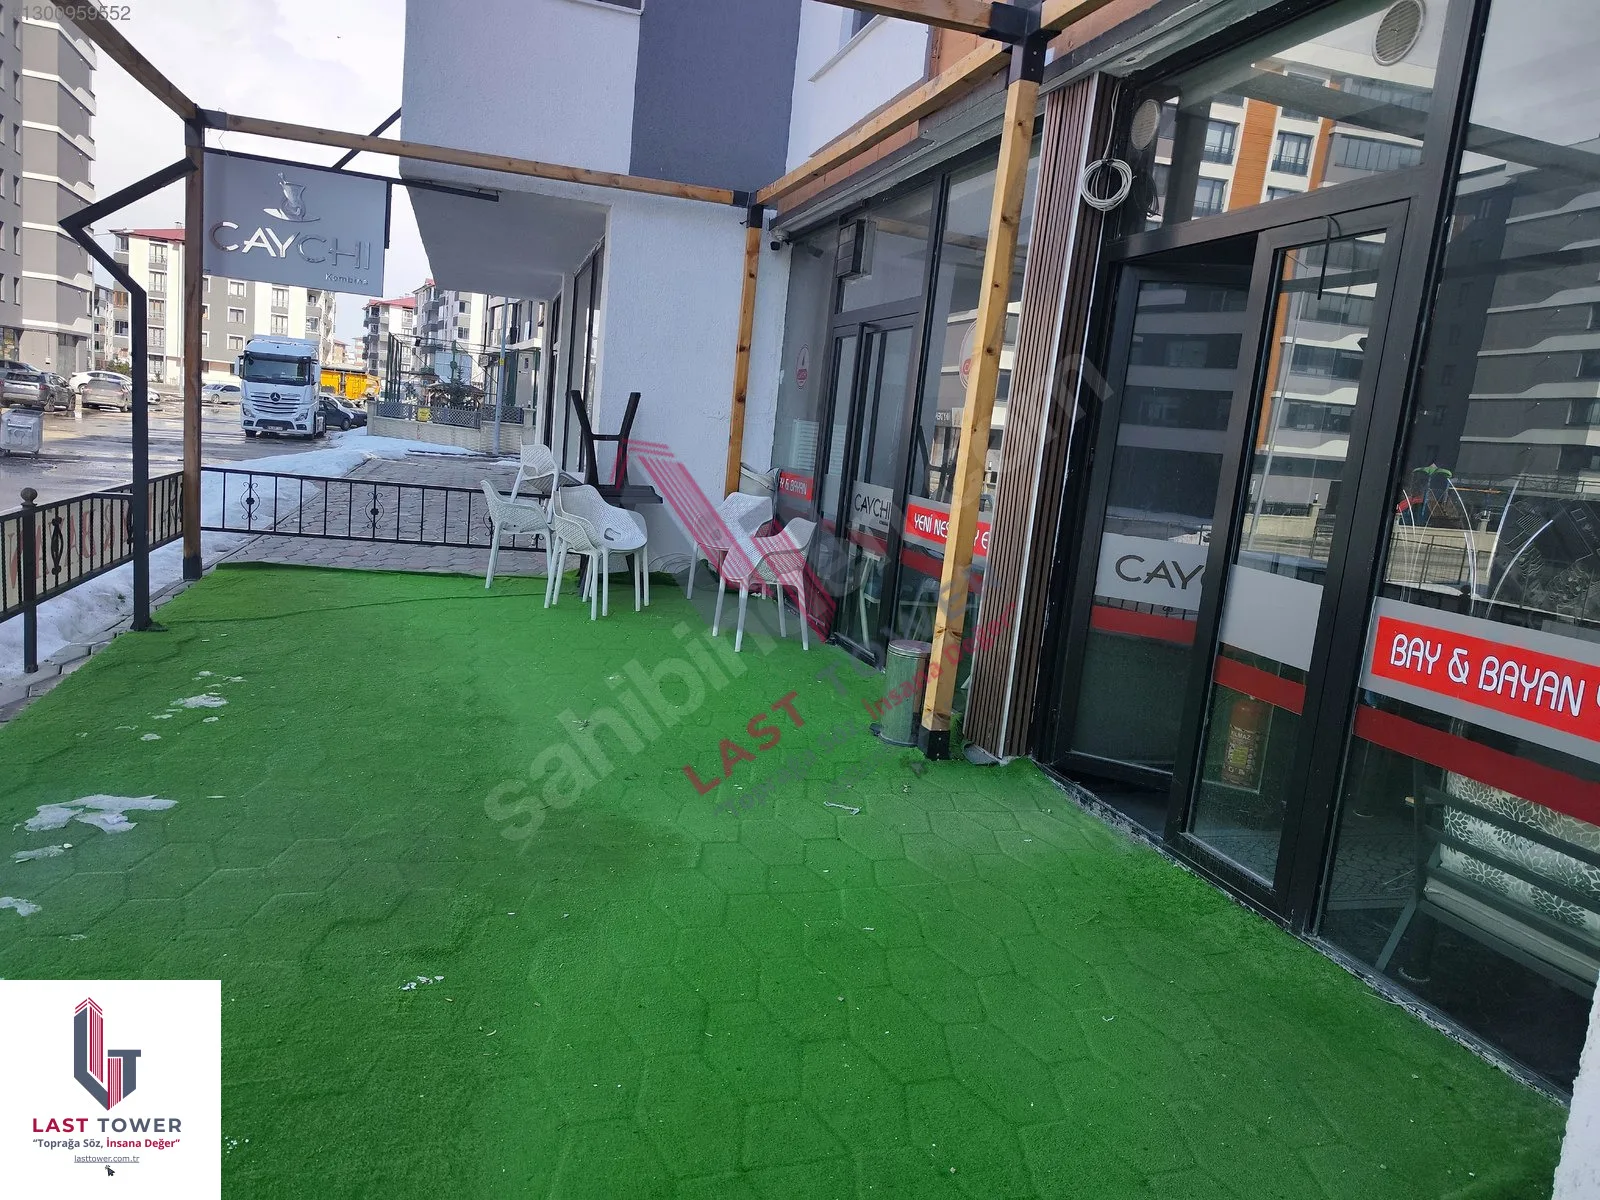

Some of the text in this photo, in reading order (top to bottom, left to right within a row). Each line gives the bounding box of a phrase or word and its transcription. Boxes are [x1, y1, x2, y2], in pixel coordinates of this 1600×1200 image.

[208, 220, 371, 270] CAYCHI
[854, 493, 891, 520] CAYCHI
[914, 512, 933, 533] YENİ
[1115, 554, 1203, 590] CAY
[1390, 634, 1442, 675] BAY
[1448, 647, 1470, 685] &
[1478, 655, 1586, 717] BAYAN
